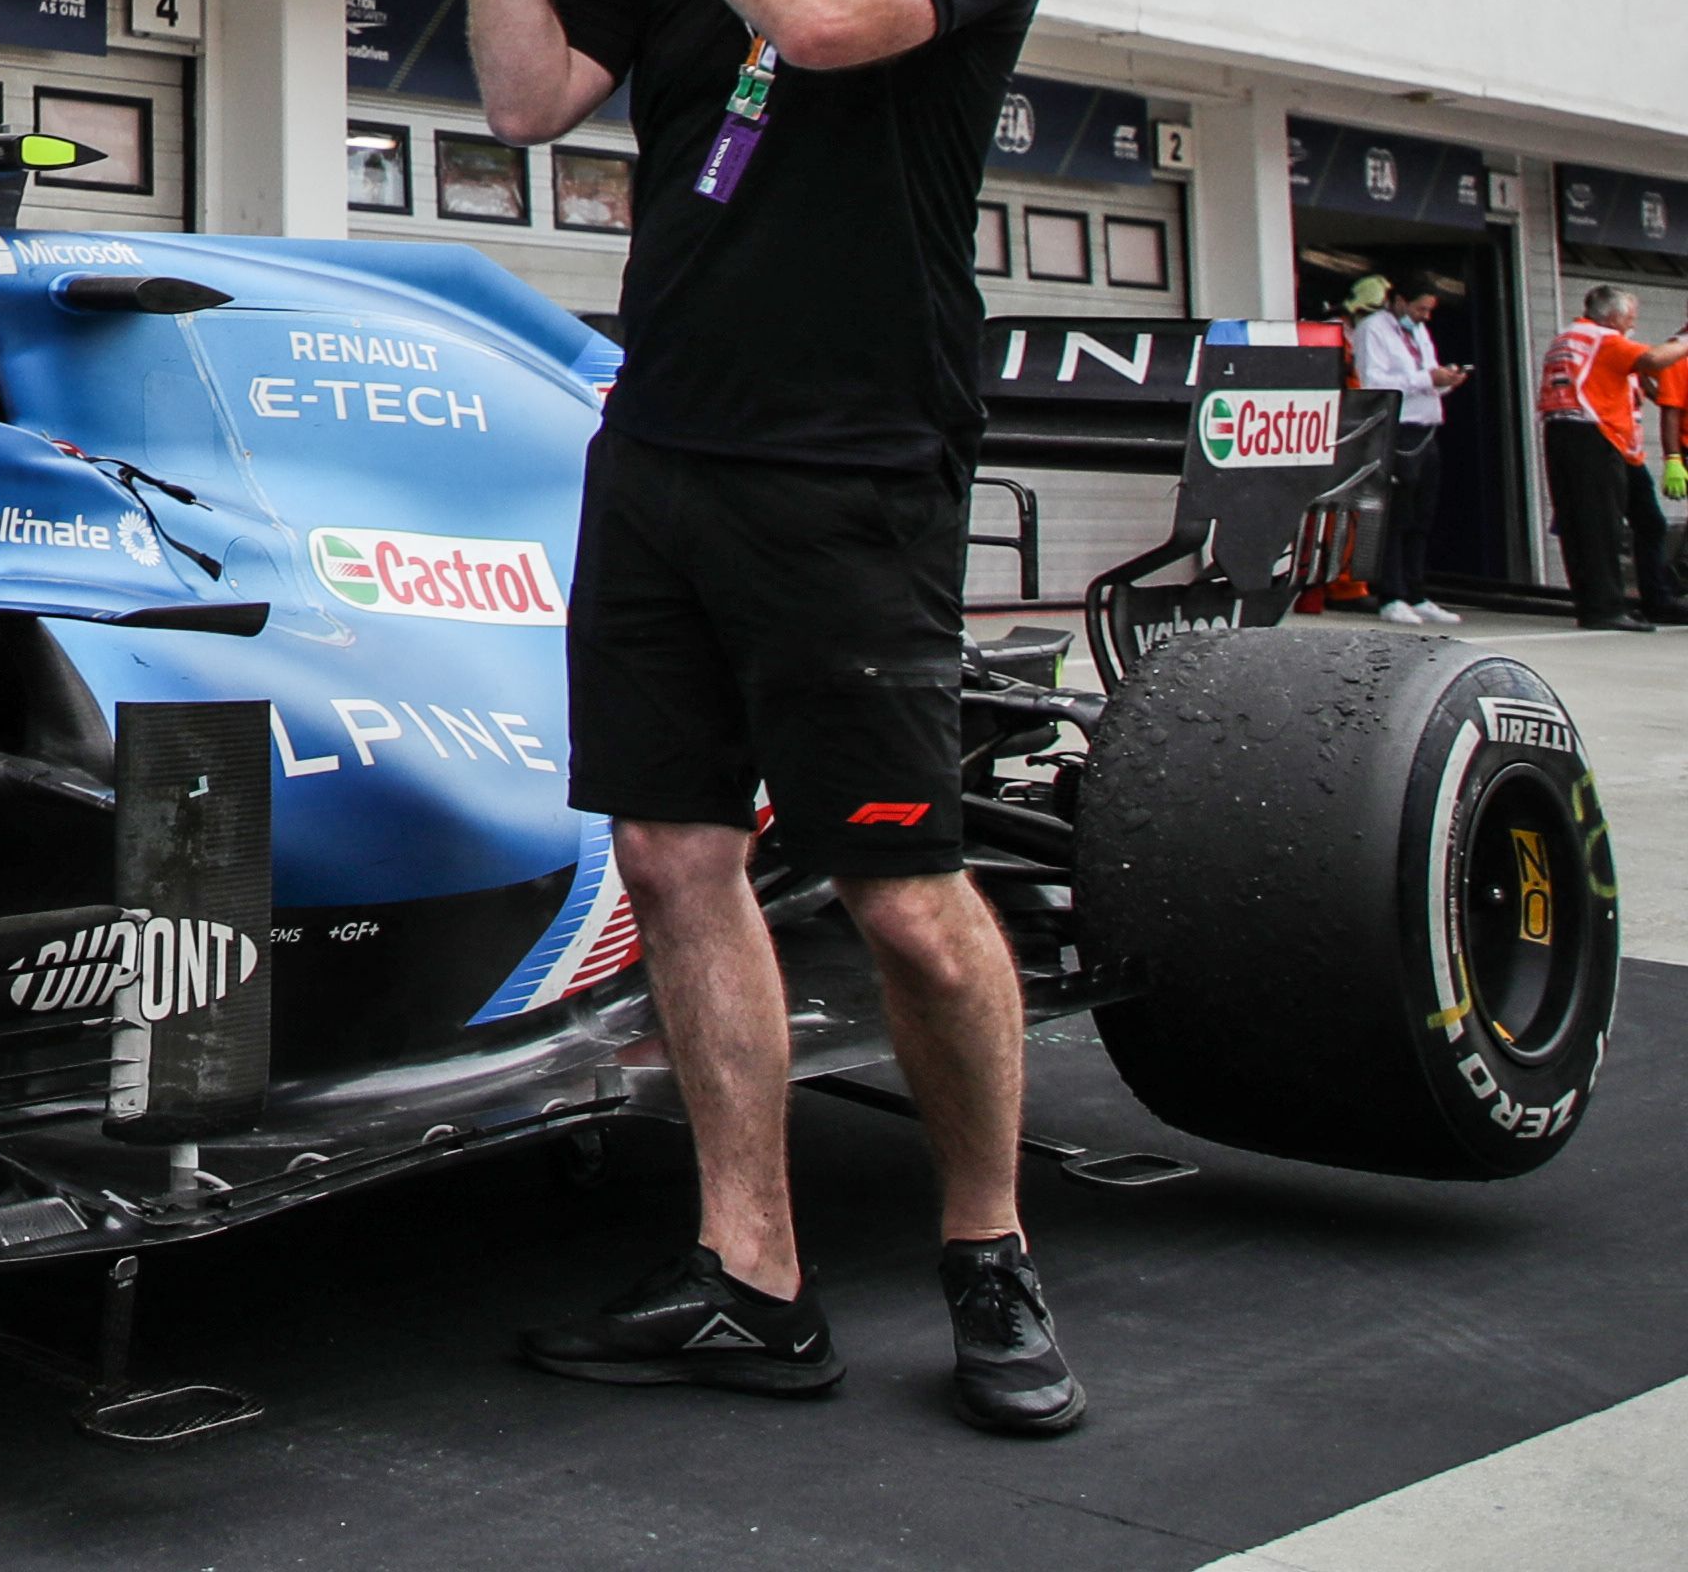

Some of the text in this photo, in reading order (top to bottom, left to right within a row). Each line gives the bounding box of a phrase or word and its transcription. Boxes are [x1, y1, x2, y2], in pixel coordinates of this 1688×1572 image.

[39, 1, 86, 18] AS ONE
[1170, 132, 1182, 162] 2
[1498, 179, 1507, 205] 1
[19, 239, 143, 267] Microsoft
[289, 330, 438, 373] RENAULT
[248, 376, 487, 432] E-TECH
[1236, 399, 1331, 458] Castrol
[374, 540, 555, 614] Castrol
[1477, 696, 1574, 753] PIRELLI
[31, 917, 234, 1022] DUPONT
[1457, 1051, 1578, 1140] ZERO
